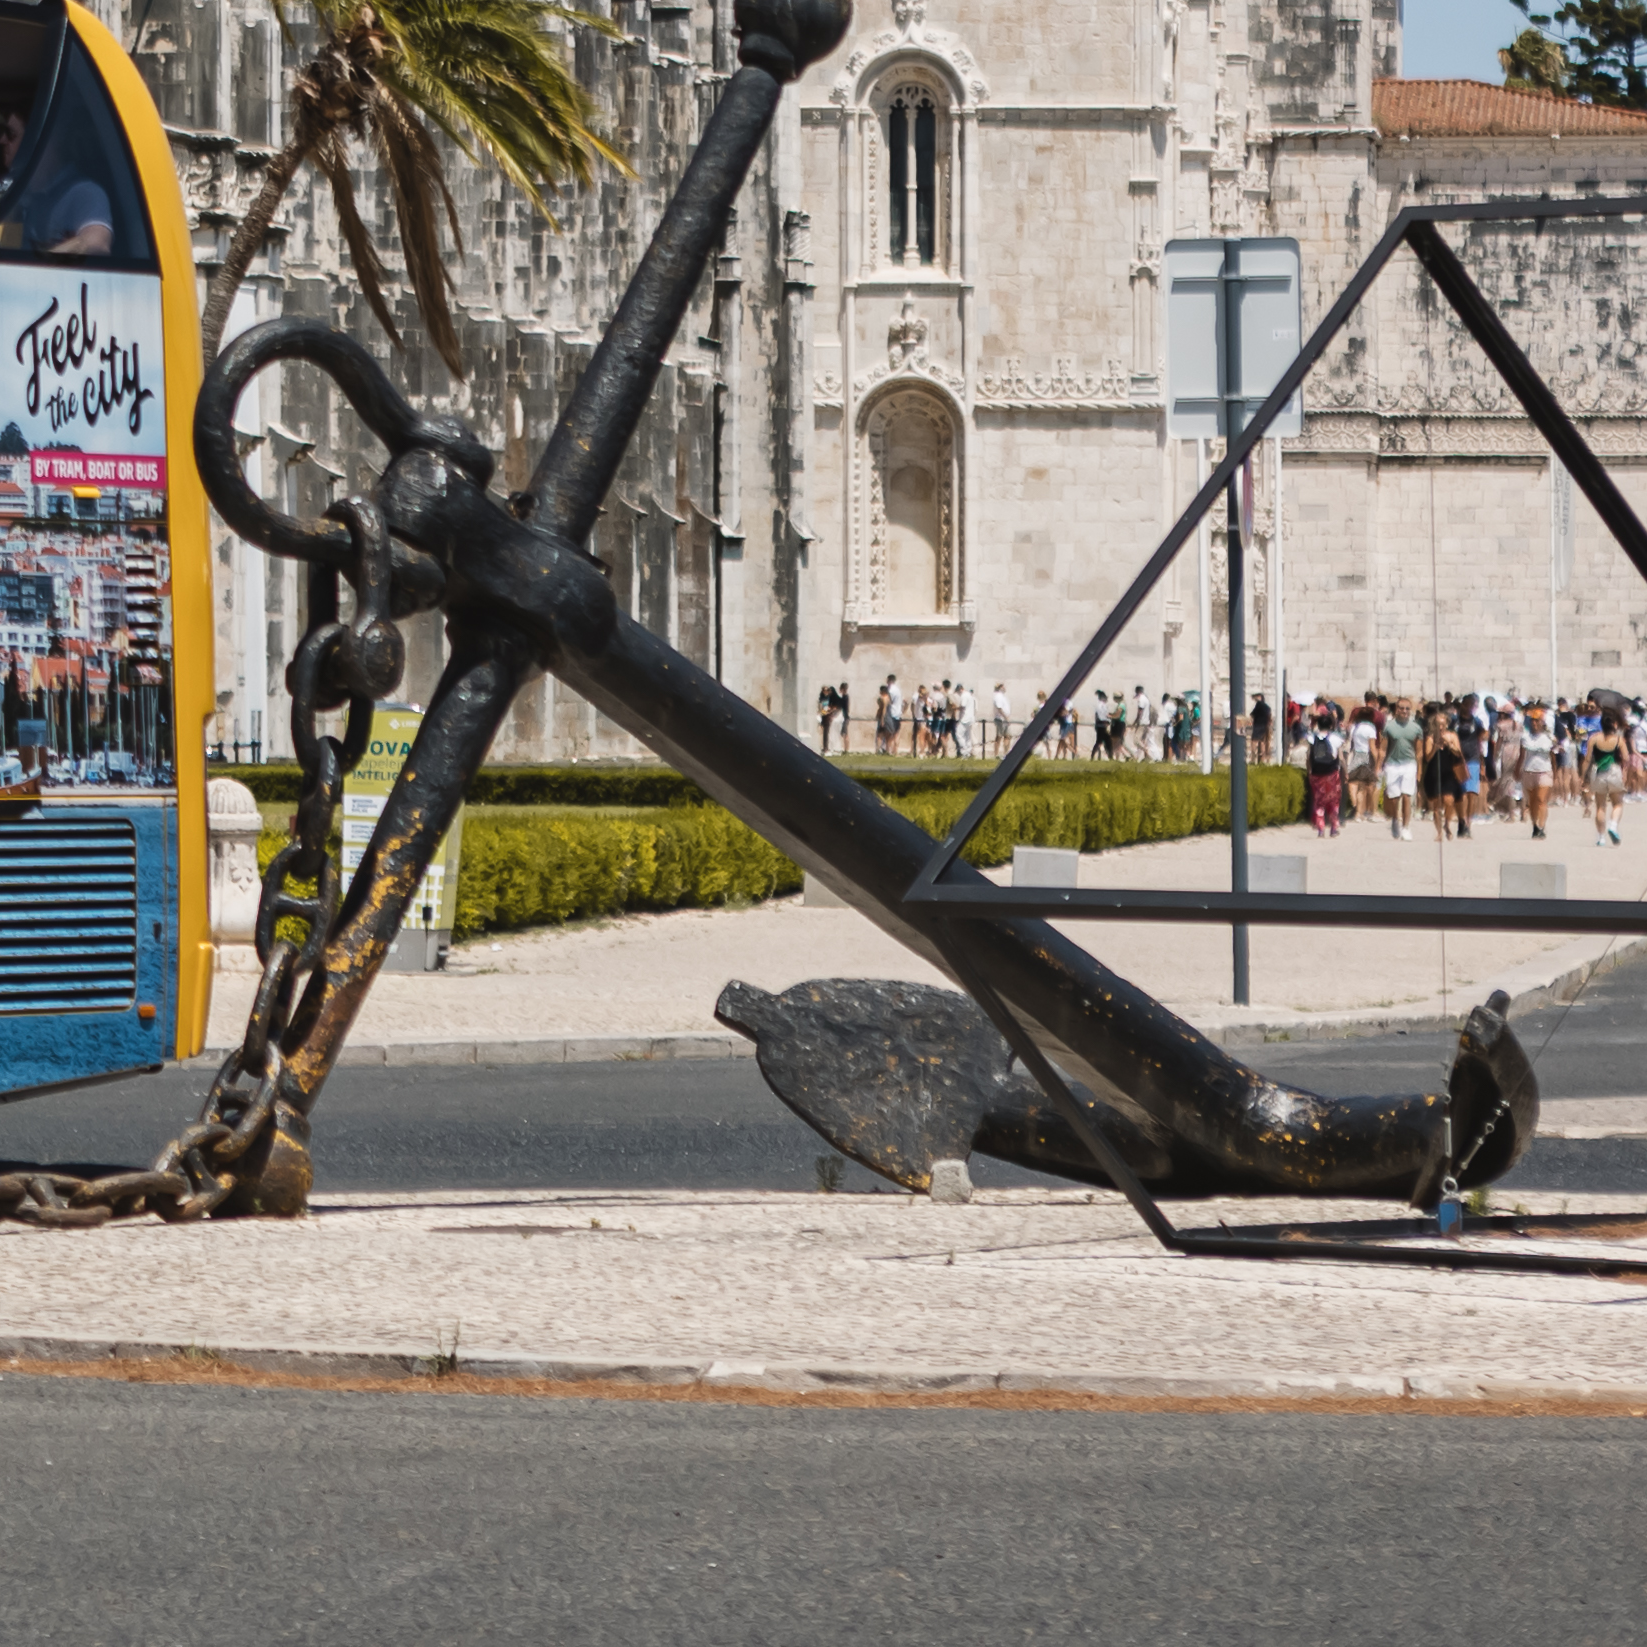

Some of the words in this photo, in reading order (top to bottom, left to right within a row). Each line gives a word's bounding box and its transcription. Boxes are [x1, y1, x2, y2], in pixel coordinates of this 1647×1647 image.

[16, 281, 97, 417] Feel
[45, 386, 79, 433] the
[83, 335, 155, 436] city
[34, 458, 52, 478] BY
[53, 459, 87, 481] TRAM,
[88, 460, 117, 480] BOAT
[119, 462, 135, 480] OR
[136, 463, 159, 482] BUS
[370, 741, 411, 756] OVA
[352, 770, 399, 781] INTELIG
